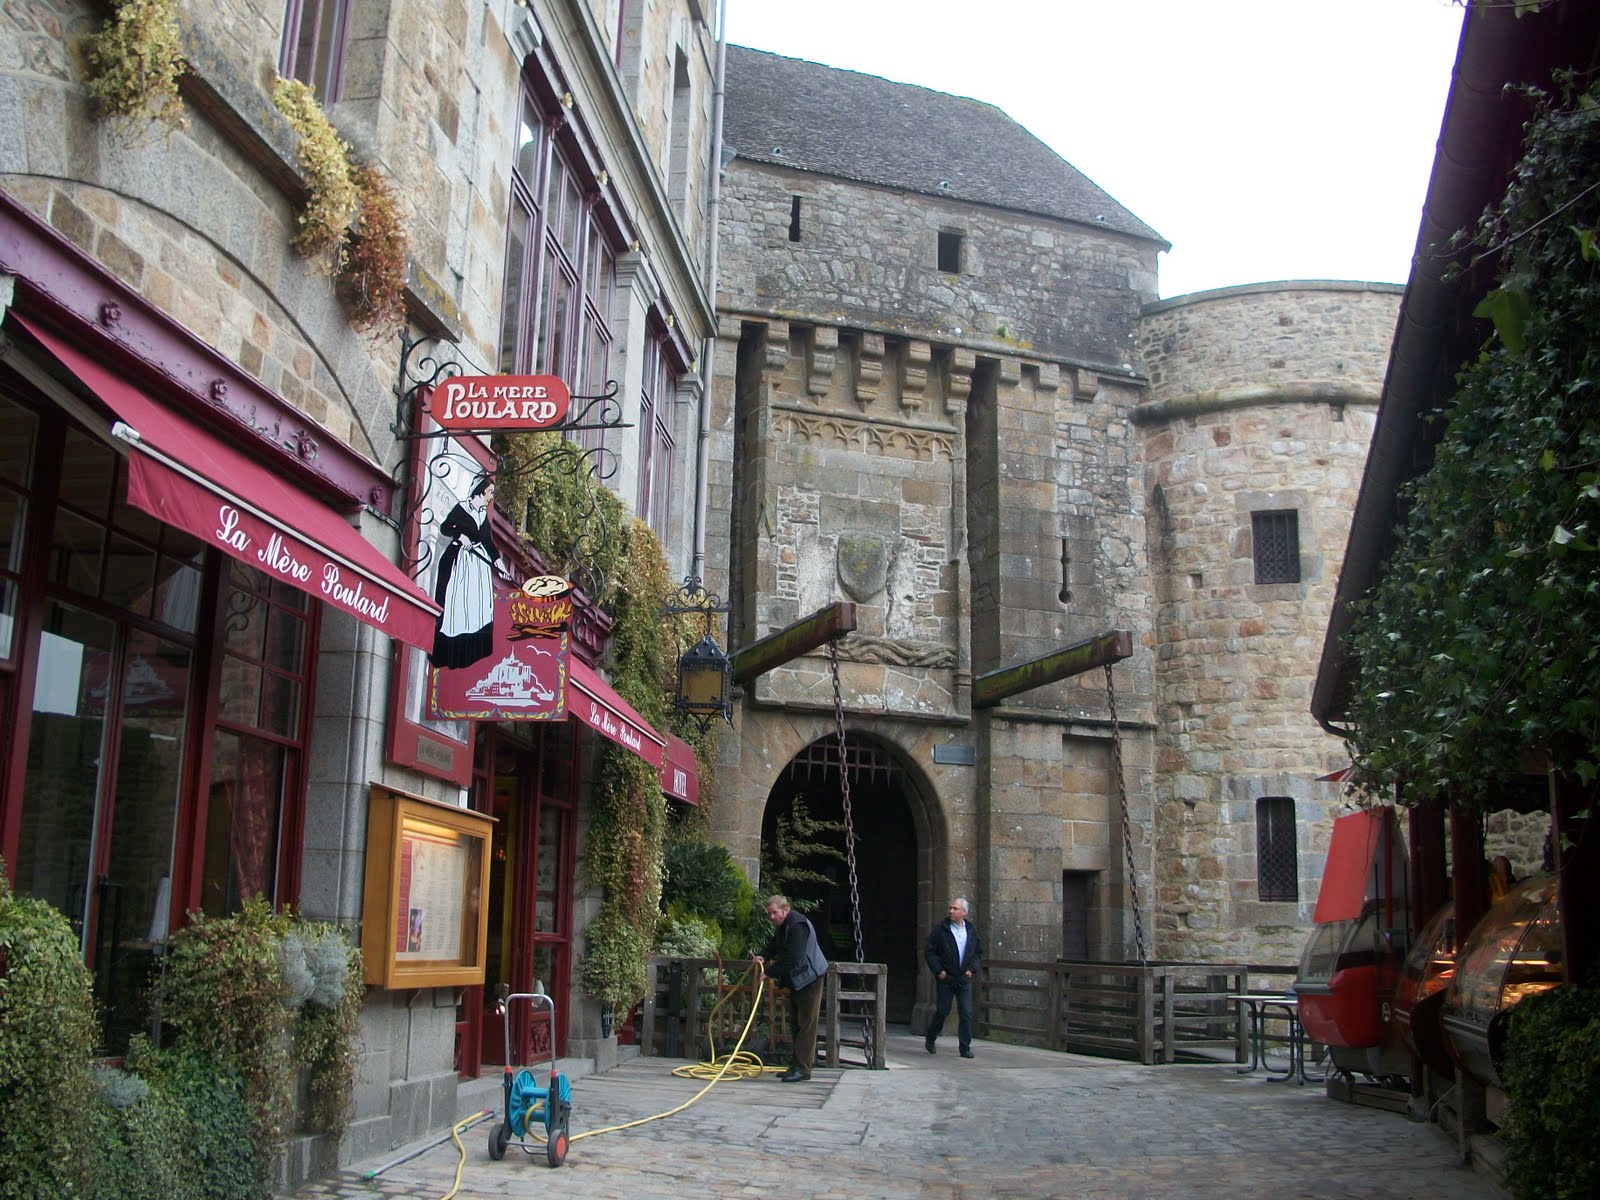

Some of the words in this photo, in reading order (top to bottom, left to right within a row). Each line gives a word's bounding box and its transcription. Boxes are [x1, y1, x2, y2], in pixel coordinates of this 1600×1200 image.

[443, 383, 558, 424] POULARD
[468, 382, 489, 398] LA
[494, 386, 548, 402] MERE
[216, 505, 251, 551] La
[257, 532, 312, 582] Mère
[321, 562, 389, 624] Poulard
[589, 702, 600, 726] La
